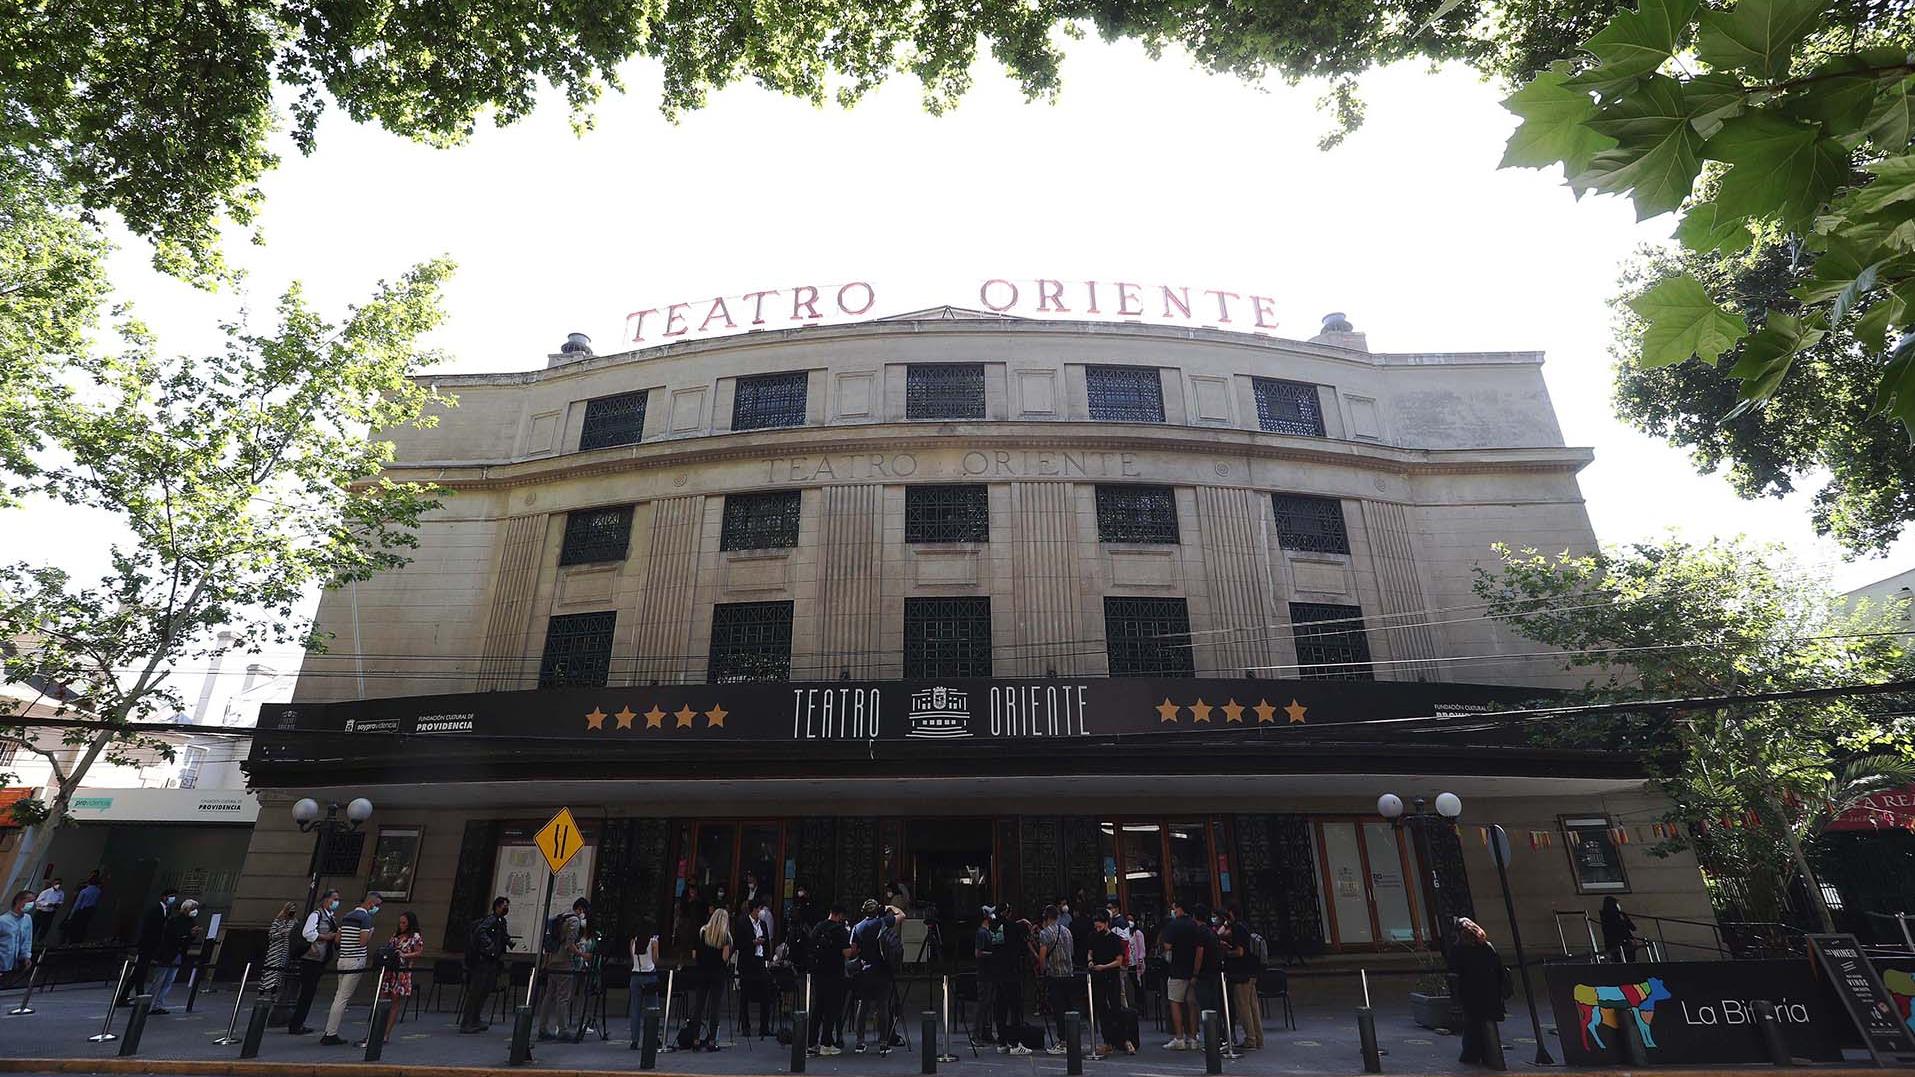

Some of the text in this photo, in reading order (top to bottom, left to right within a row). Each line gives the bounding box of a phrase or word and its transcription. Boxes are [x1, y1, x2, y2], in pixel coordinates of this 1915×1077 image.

[625, 278, 1279, 342] TEATRO ORIENTE
[762, 451, 1142, 483] TEATRO ORIENTE
[416, 721, 473, 732] PROVIDENCIA
[446, 713, 466, 721] CULTURAL
[794, 686, 1090, 738] TEATRO ORIENTE
[1681, 997, 1810, 1025] La Bifría
